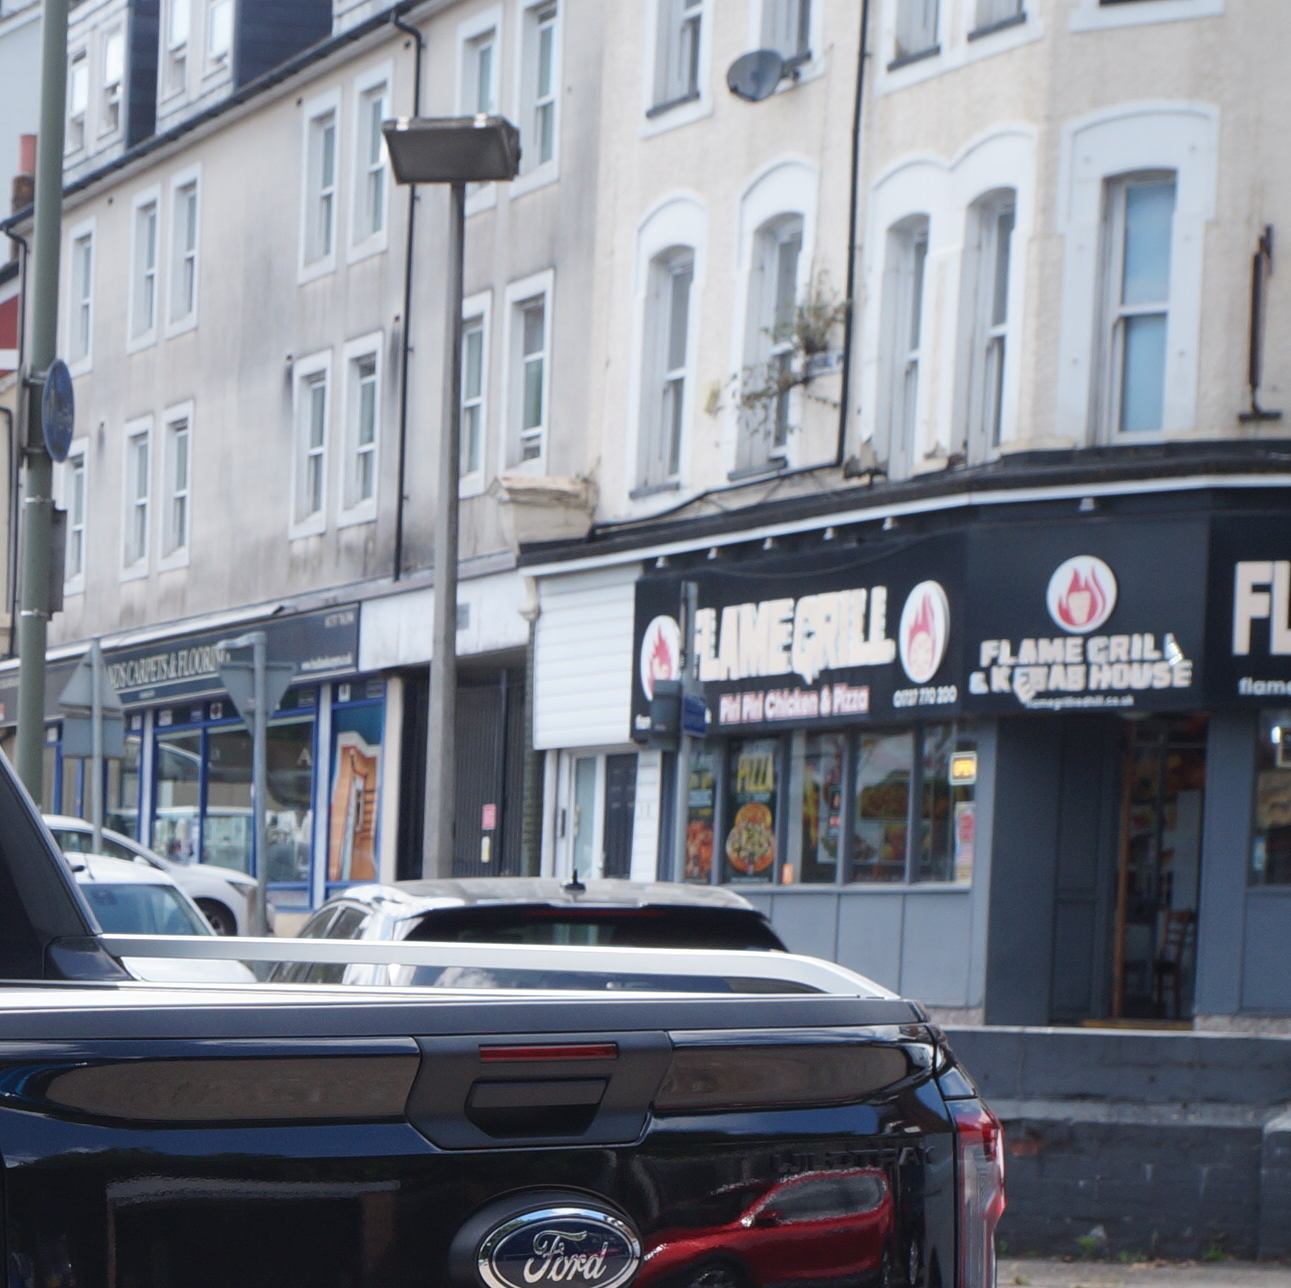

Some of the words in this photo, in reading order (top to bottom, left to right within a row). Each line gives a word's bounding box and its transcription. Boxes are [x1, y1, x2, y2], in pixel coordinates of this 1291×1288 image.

[791, 585, 897, 686] GRILL
[979, 636, 1084, 668] FLAME
[969, 671, 989, 695] &
[1088, 659, 1193, 691] HOUSE
[719, 693, 741, 725] Piri
[742, 690, 764, 723] Piri
[764, 686, 818, 721] Chicken
[819, 683, 831, 717] &
[832, 681, 870, 716] Pizza
[523, 1229, 609, 1284] Ford
